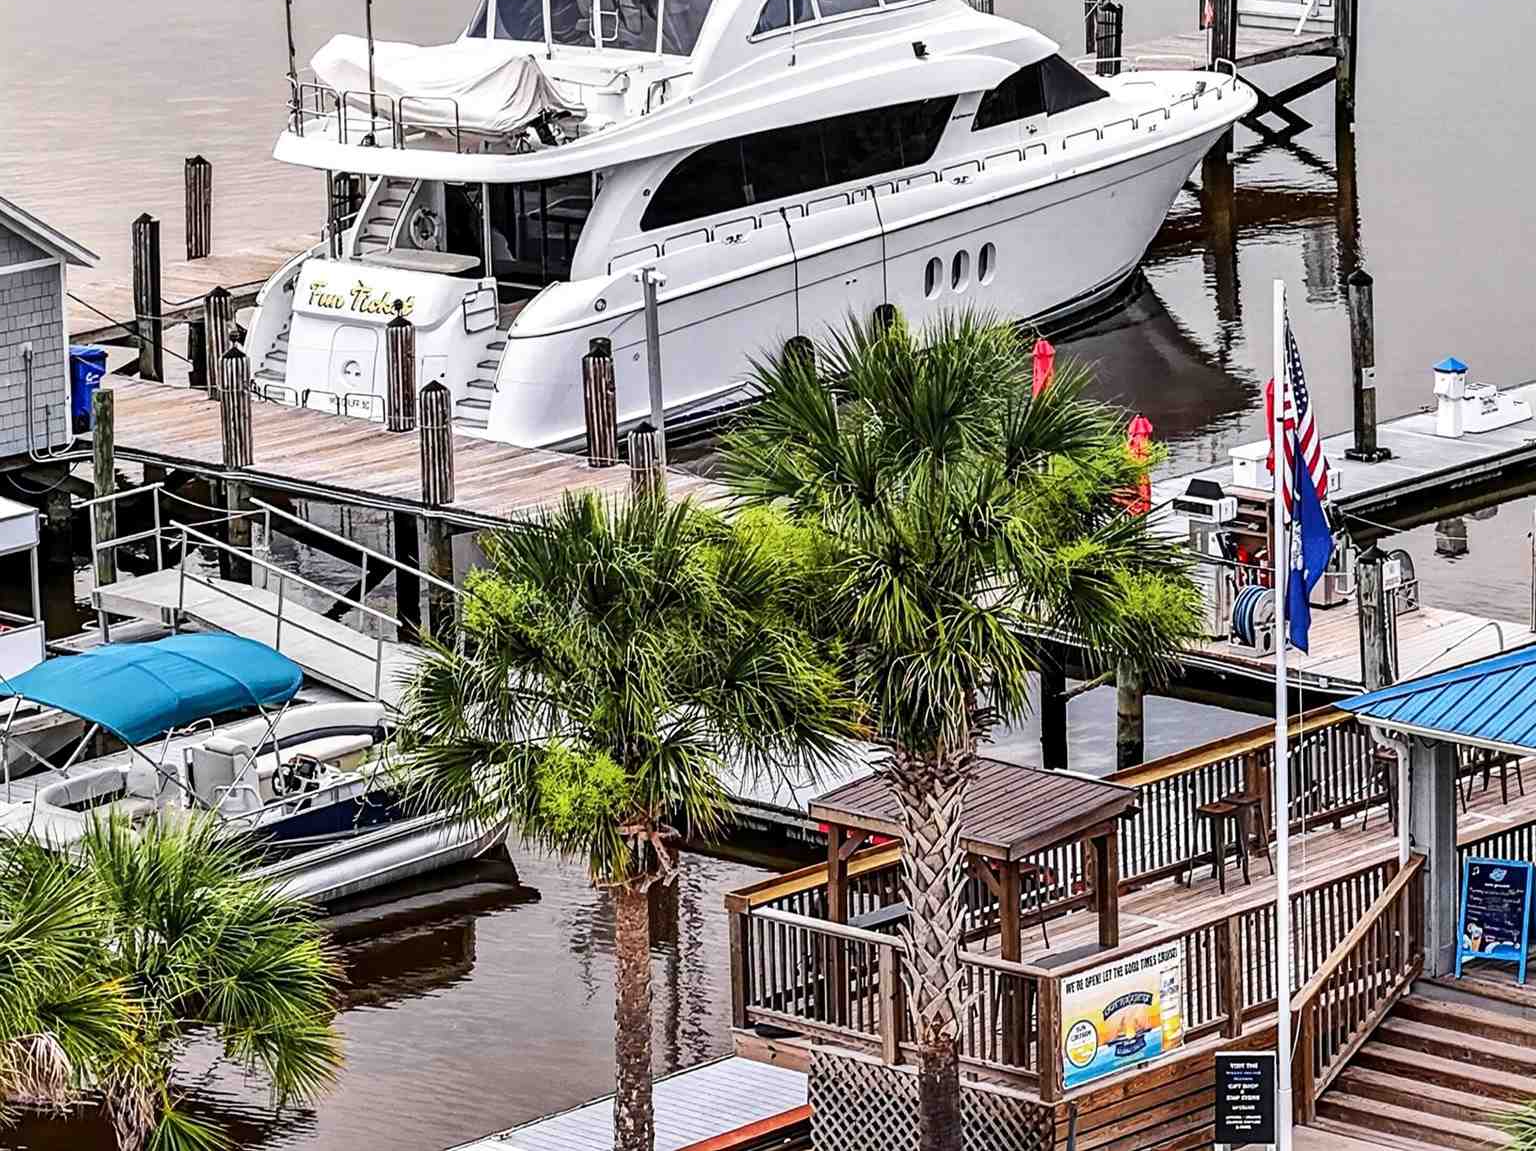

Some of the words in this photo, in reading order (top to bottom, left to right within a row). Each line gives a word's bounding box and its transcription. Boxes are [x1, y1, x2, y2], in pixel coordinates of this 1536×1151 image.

[308, 281, 344, 309] Fun
[350, 280, 416, 317] Tickt
[1103, 968, 1112, 983] LET
[1113, 964, 1124, 979] THE
[1124, 959, 1139, 975] GOOD
[1141, 953, 1156, 969] TIMES
